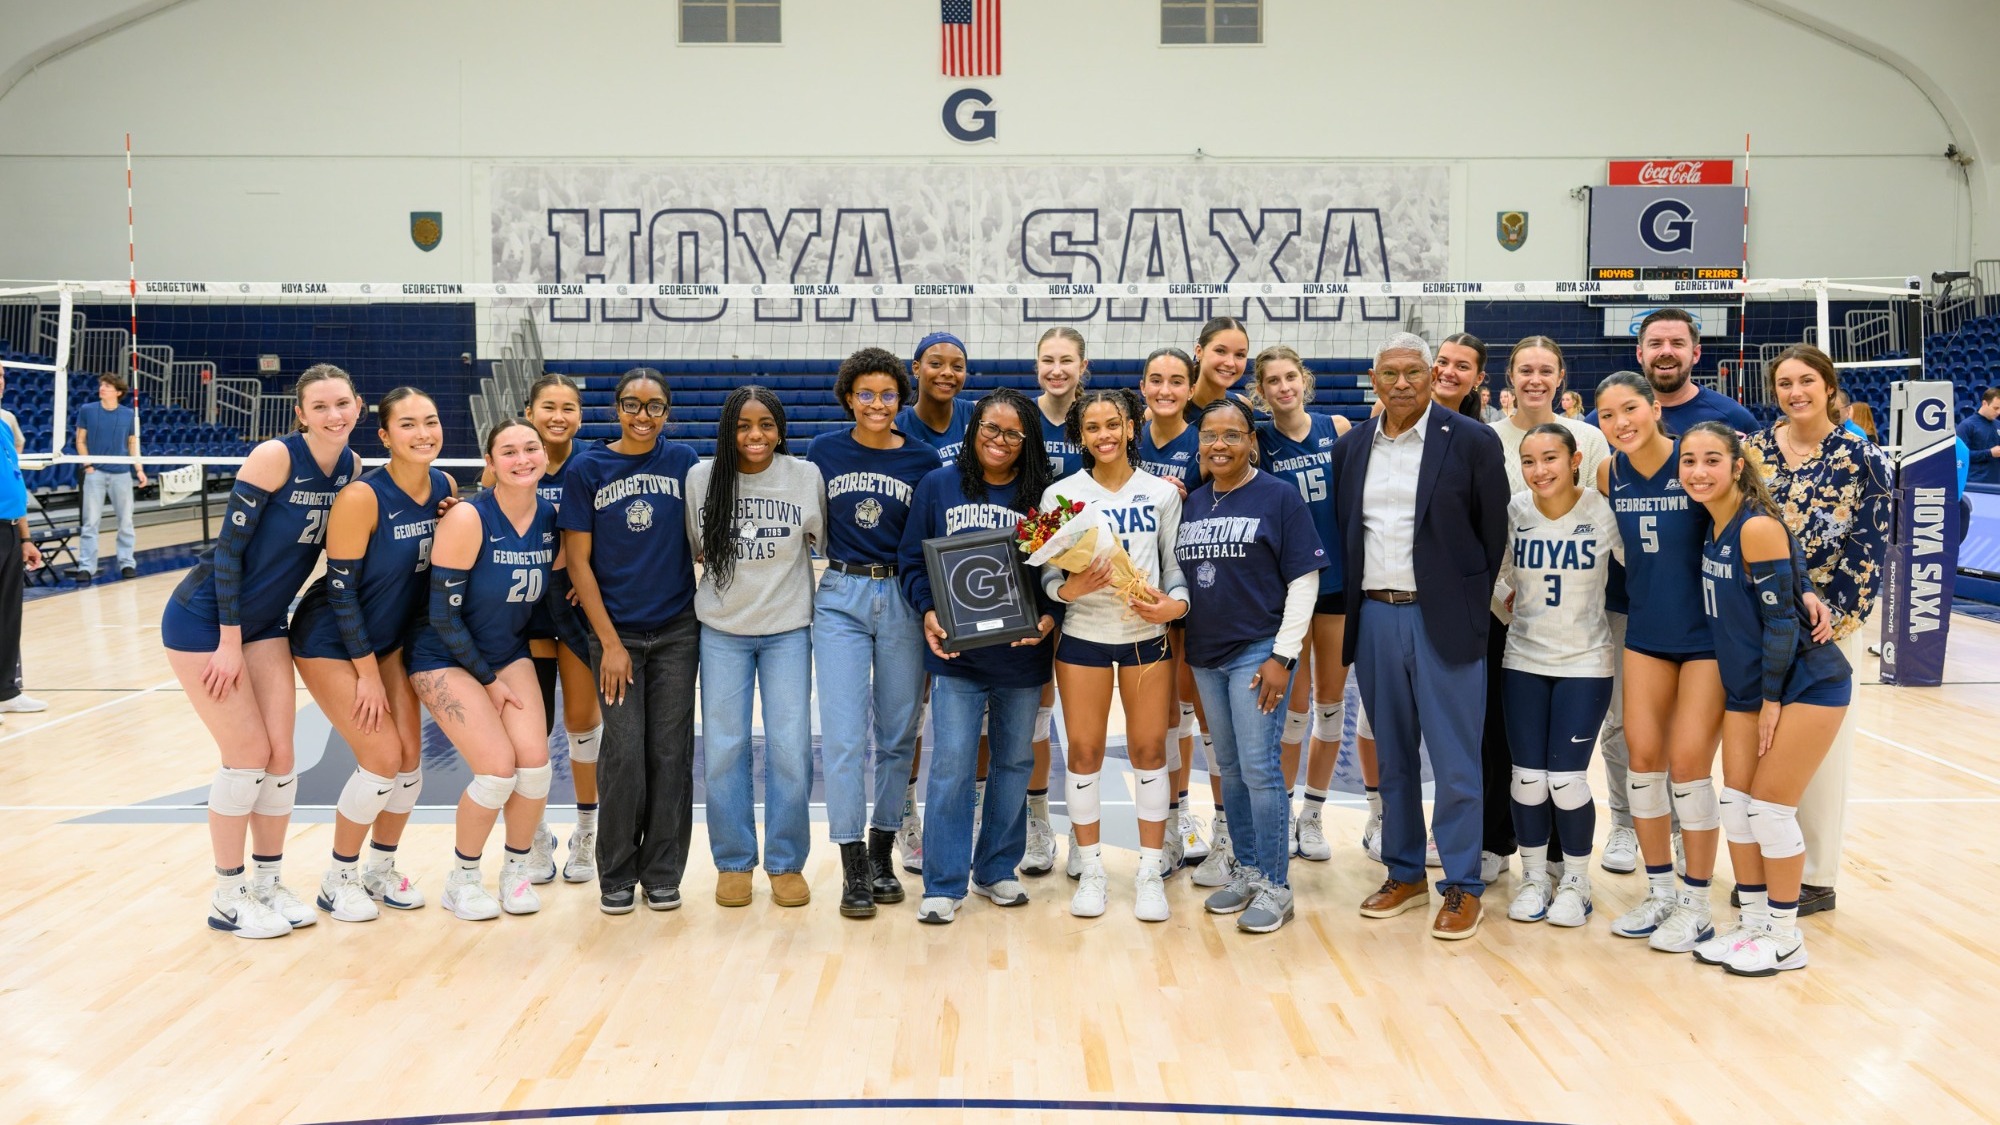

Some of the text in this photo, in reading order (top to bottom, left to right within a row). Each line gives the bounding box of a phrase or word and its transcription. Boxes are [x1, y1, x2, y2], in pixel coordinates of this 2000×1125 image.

[941, 87, 999, 142] G
[1638, 198, 1698, 254] G
[548, 209, 1400, 323] HOYA SAXA
[1599, 269, 1635, 279] HOYAS
[1698, 269, 1738, 279] FRIARS
[146, 282, 206, 293] GEORGETOWN
[281, 283, 327, 294] HOYA SAXA
[402, 283, 463, 294] GEORGETOWN
[537, 284, 583, 295] HOYA SAXA
[659, 284, 719, 295] GEORGETOWN
[793, 284, 840, 295] HOYA SAXA
[914, 284, 974, 295] GEORGETOWN
[1048, 284, 1094, 295] HOYA SAXA
[1169, 283, 1229, 294] GEORGETOWN
[1303, 283, 1348, 294] HOYA SAXA
[1422, 282, 1482, 293] GEORGETOWN
[1555, 281, 1601, 292] HOYA SAXA
[1674, 280, 1734, 291] GEORGETOWN
[1914, 397, 1948, 432] G
[1272, 451, 1332, 473] GEORGETOW
[594, 473, 682, 511] GEORGETOWN
[1295, 468, 1327, 503] 15
[288, 490, 339, 506] GEORGETO
[1614, 495, 1689, 512] GEORGETOWN
[231, 510, 247, 527] G
[297, 509, 329, 544] 21
[945, 503, 1028, 537] GEORGETO
[1101, 504, 1157, 534] YAS
[1913, 487, 1946, 556] HOYA
[763, 528, 783, 537] 1789
[1639, 515, 1660, 553] 5
[415, 537, 433, 573] 9
[736, 542, 776, 560] OYAS
[1513, 537, 1597, 570] HOYAS
[505, 568, 543, 603] 20
[950, 554, 1014, 611] G
[1544, 574, 1562, 608] 3
[449, 593, 463, 607] G
[1761, 590, 1779, 605] G
[1882, 641, 1896, 665] G
